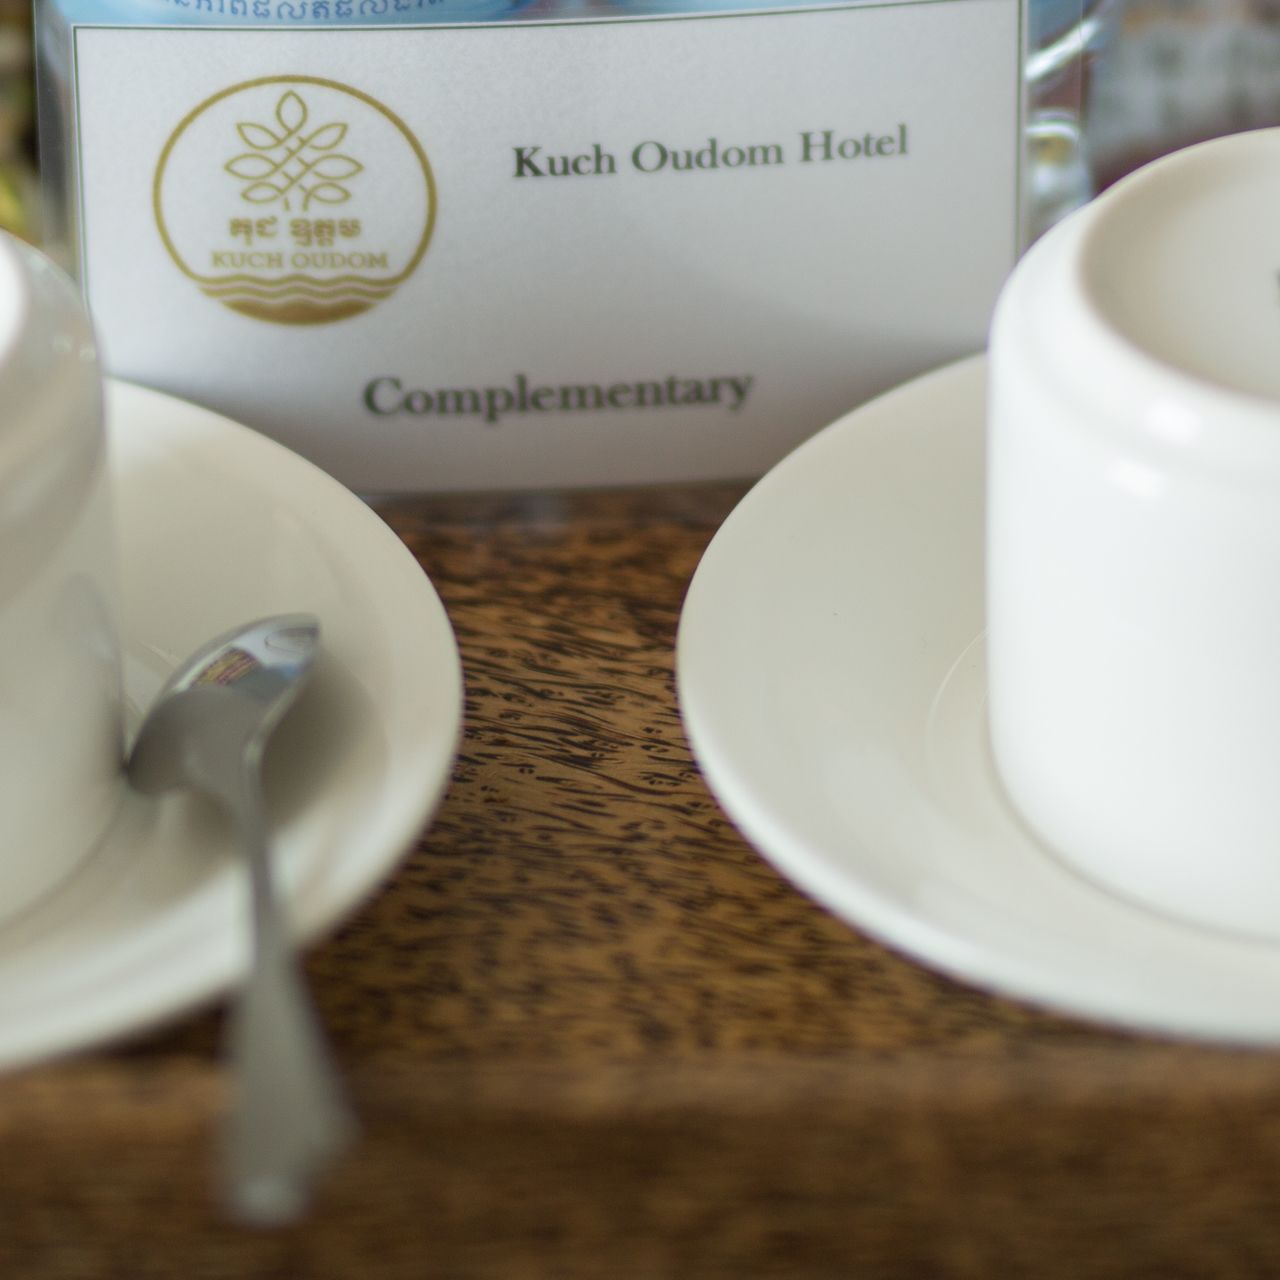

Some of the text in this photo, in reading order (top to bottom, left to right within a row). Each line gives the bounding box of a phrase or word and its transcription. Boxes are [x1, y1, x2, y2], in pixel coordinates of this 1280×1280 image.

[512, 123, 910, 178] Kuch Oudom Hotel
[211, 251, 389, 269] KUCH OUDOM
[362, 373, 755, 424] Complementary
